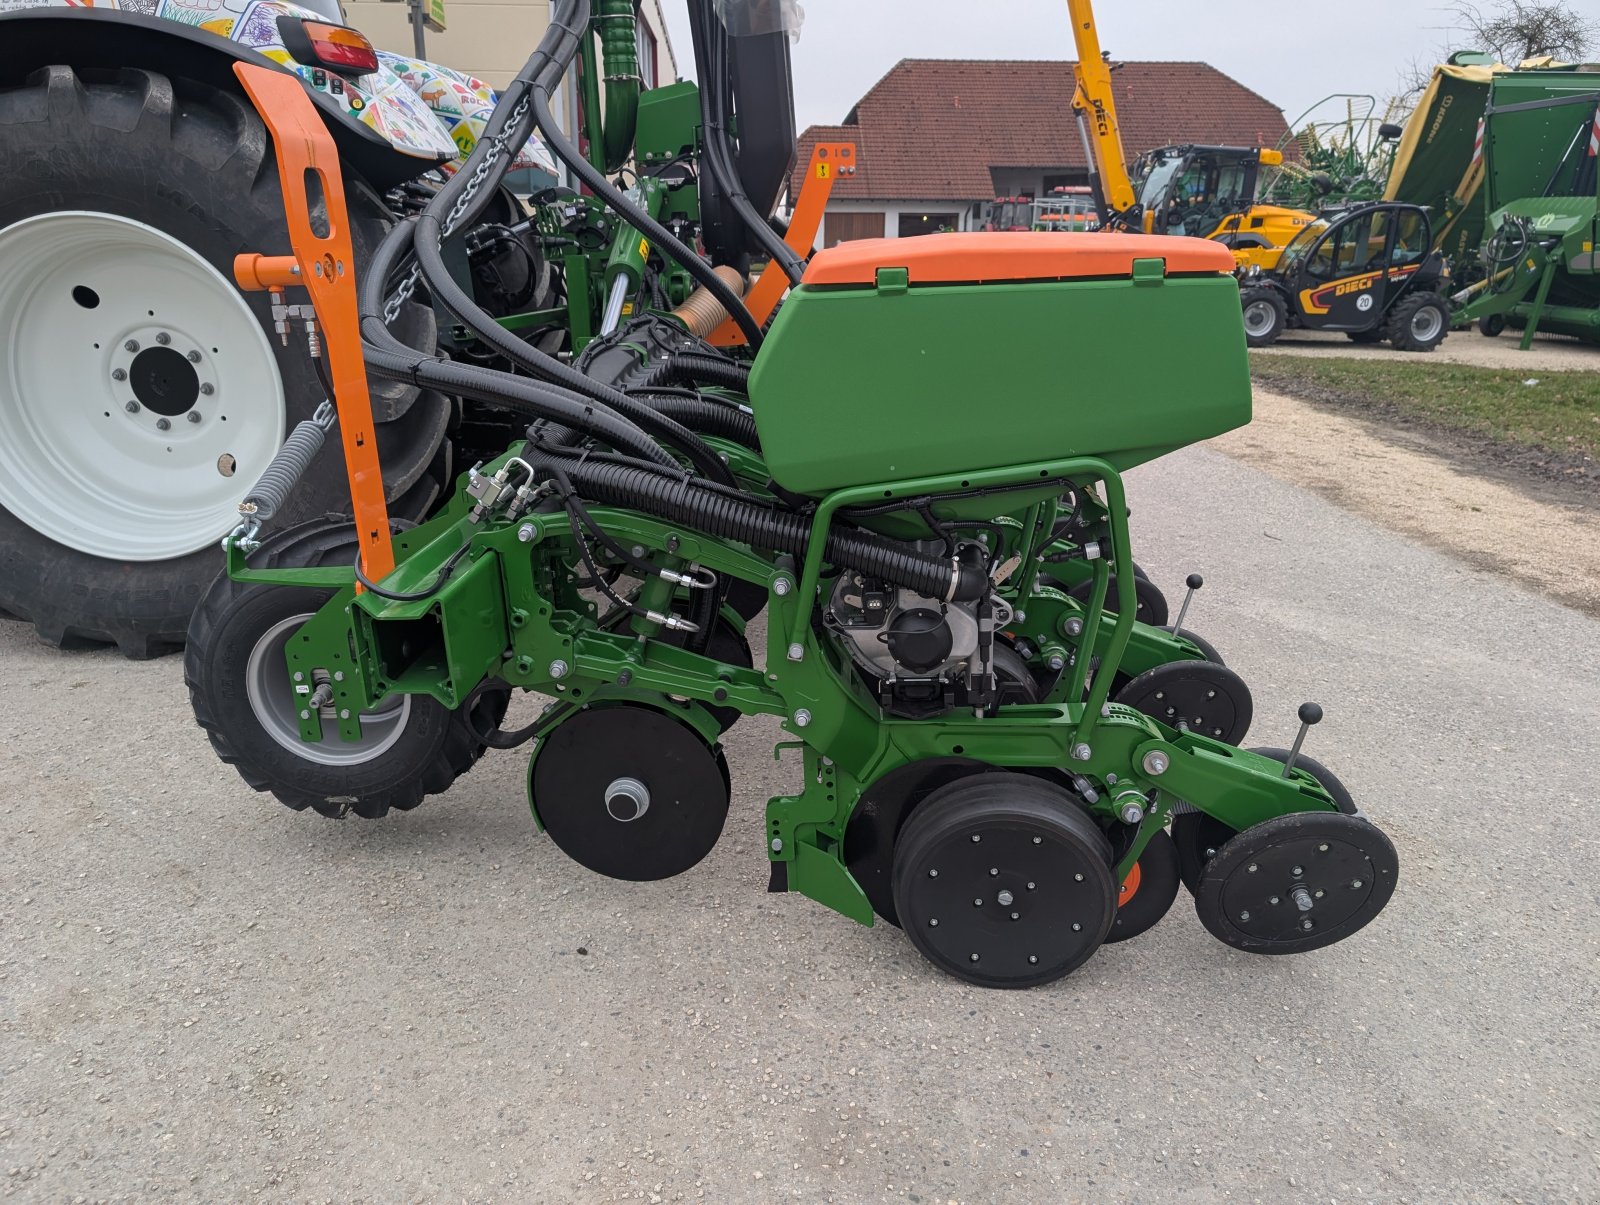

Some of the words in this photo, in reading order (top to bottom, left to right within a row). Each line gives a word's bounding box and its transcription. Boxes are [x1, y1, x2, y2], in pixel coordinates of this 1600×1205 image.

[1426, 106, 1447, 145] KRONE
[1335, 278, 1373, 297] DIECI
[1359, 297, 1370, 308] 20
